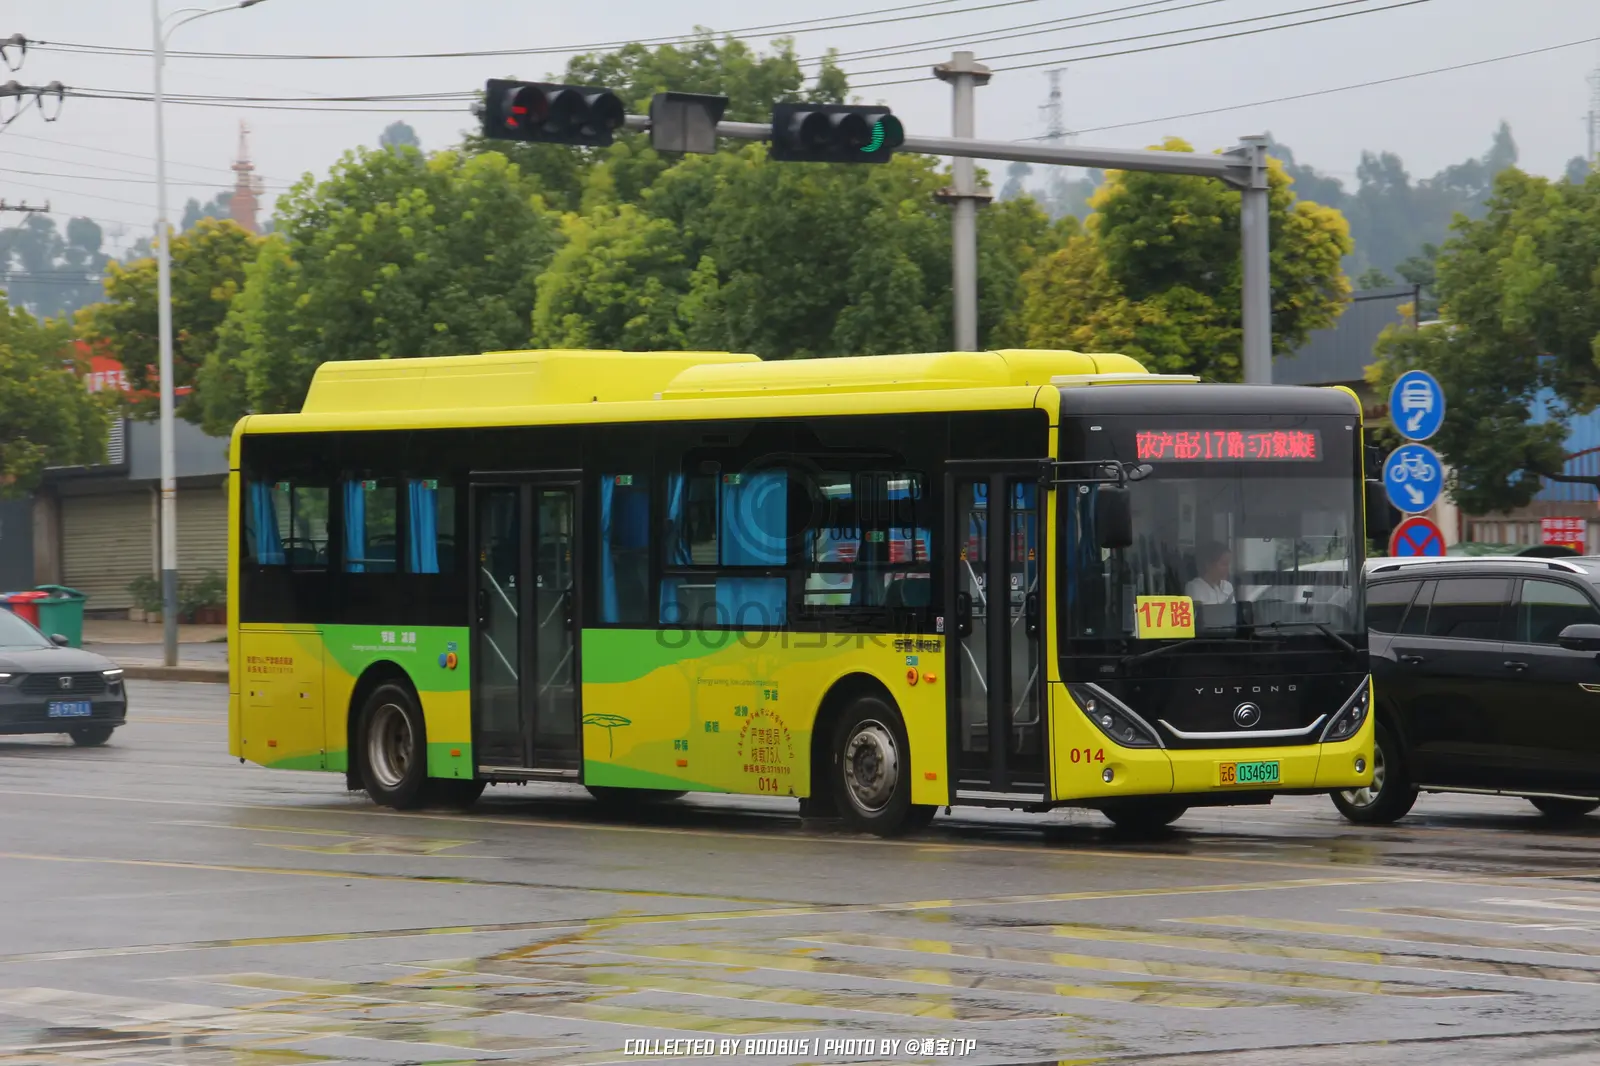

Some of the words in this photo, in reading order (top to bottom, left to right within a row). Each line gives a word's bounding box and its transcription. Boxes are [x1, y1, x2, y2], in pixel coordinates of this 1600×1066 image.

[1139, 601, 1191, 628] 17路
[1195, 685, 1297, 694] YUTONG
[1070, 748, 1105, 764] 014
[758, 777, 778, 792] 014
